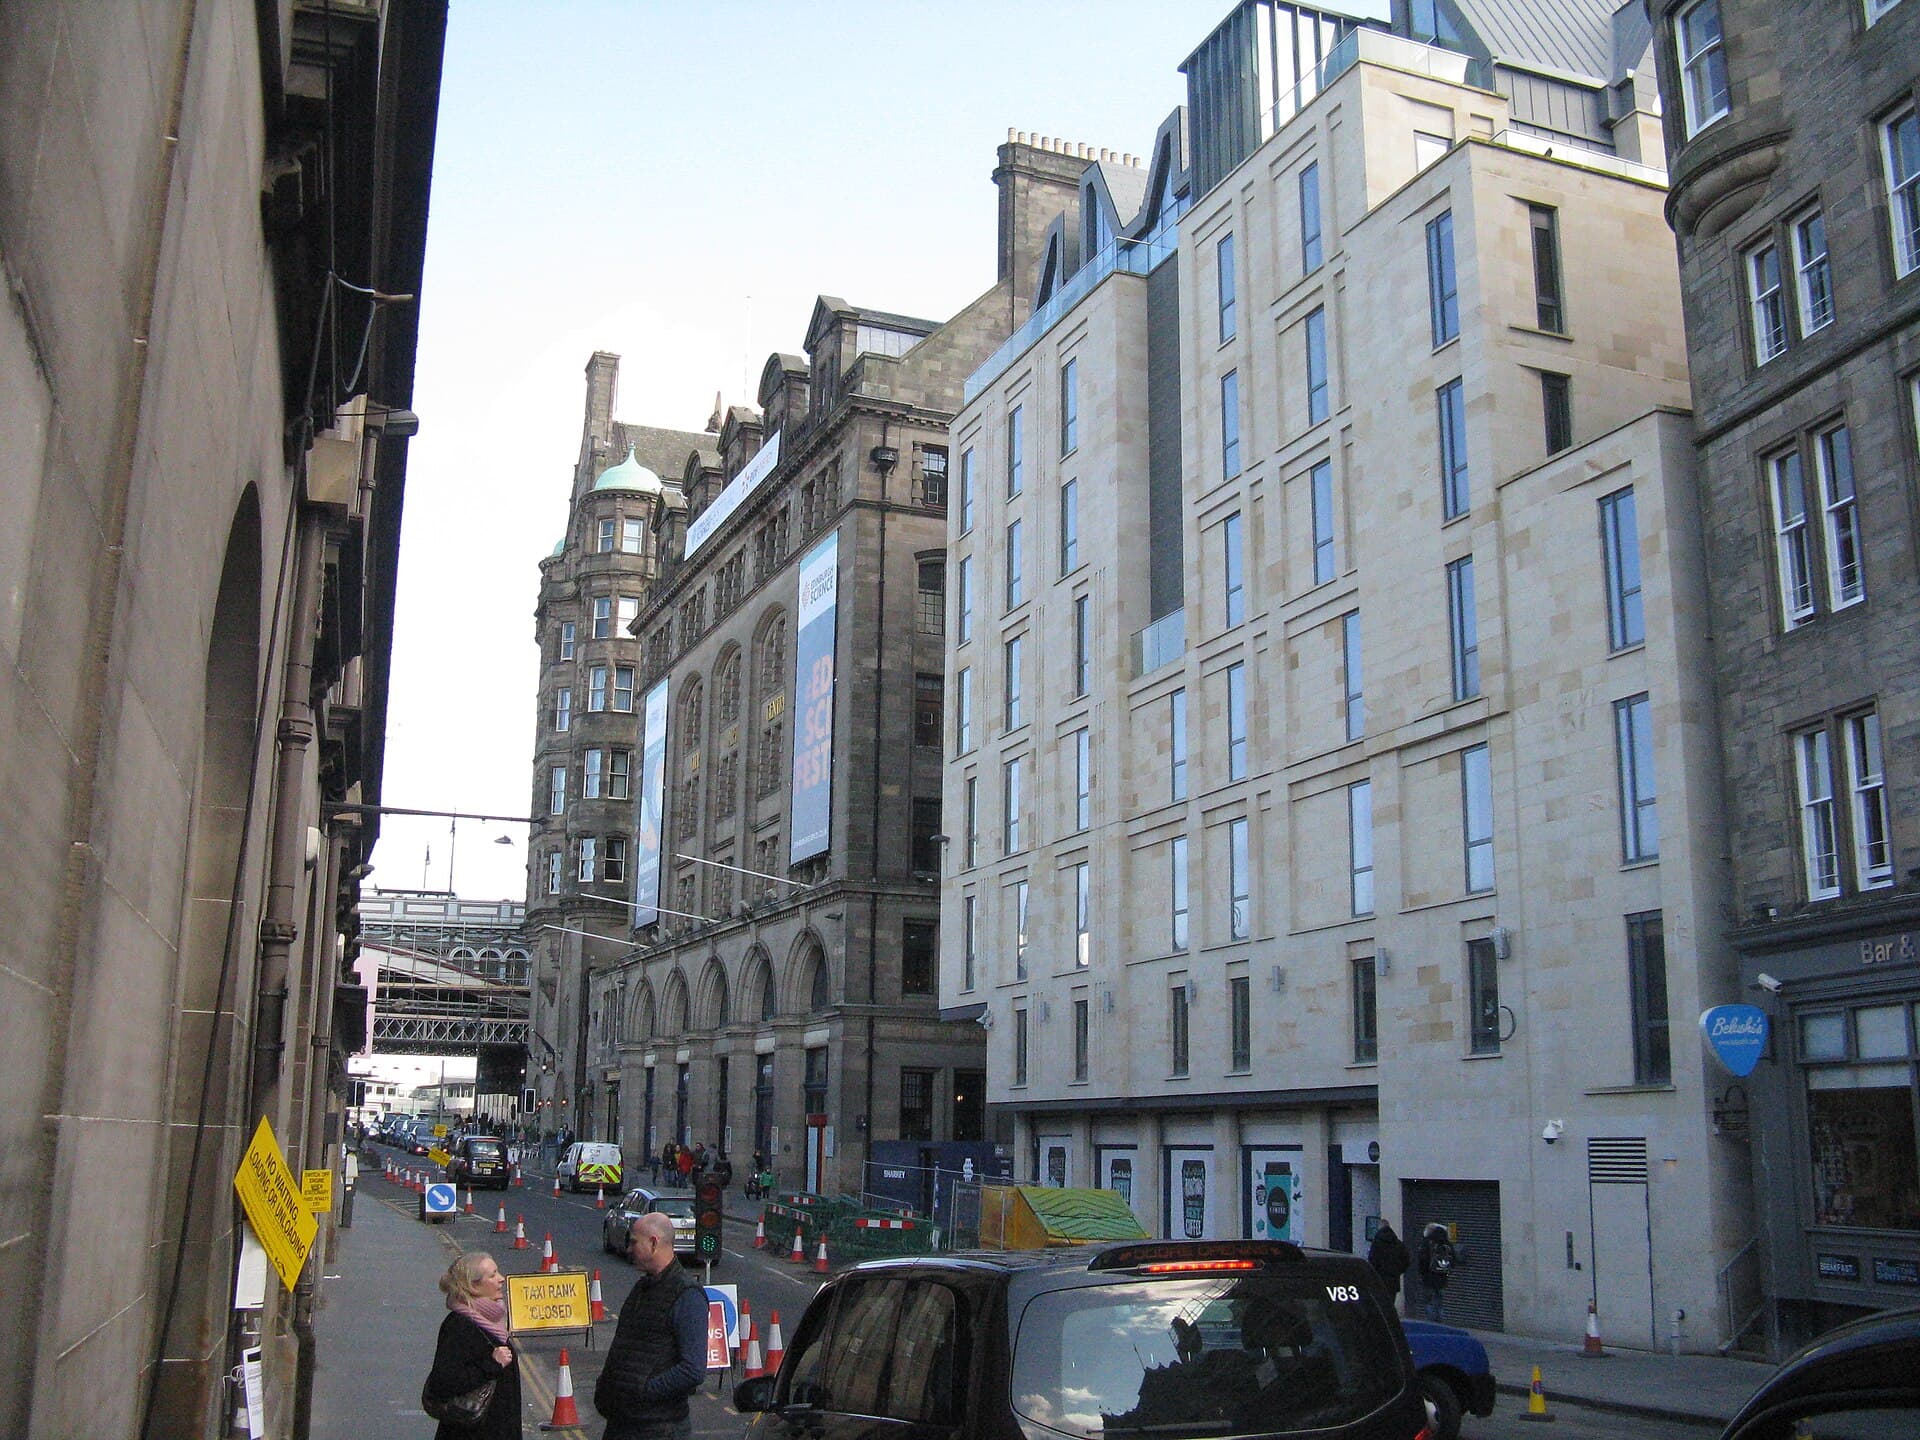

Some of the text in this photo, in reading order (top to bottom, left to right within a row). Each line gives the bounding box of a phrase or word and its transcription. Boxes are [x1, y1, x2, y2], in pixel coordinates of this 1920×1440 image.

[810, 576, 833, 604] SCIENCE
[1860, 934, 1915, 964] Bar &
[1712, 1015, 1763, 1036] Belushi's
[265, 1152, 277, 1174] NO
[249, 1146, 271, 1193] LOADING
[267, 1190, 277, 1209] OR
[275, 1206, 305, 1258] UNLOADING
[523, 1283, 577, 1301] TAXI RANK
[1326, 1284, 1360, 1302] V83
[530, 1304, 573, 1320] CLOSED
